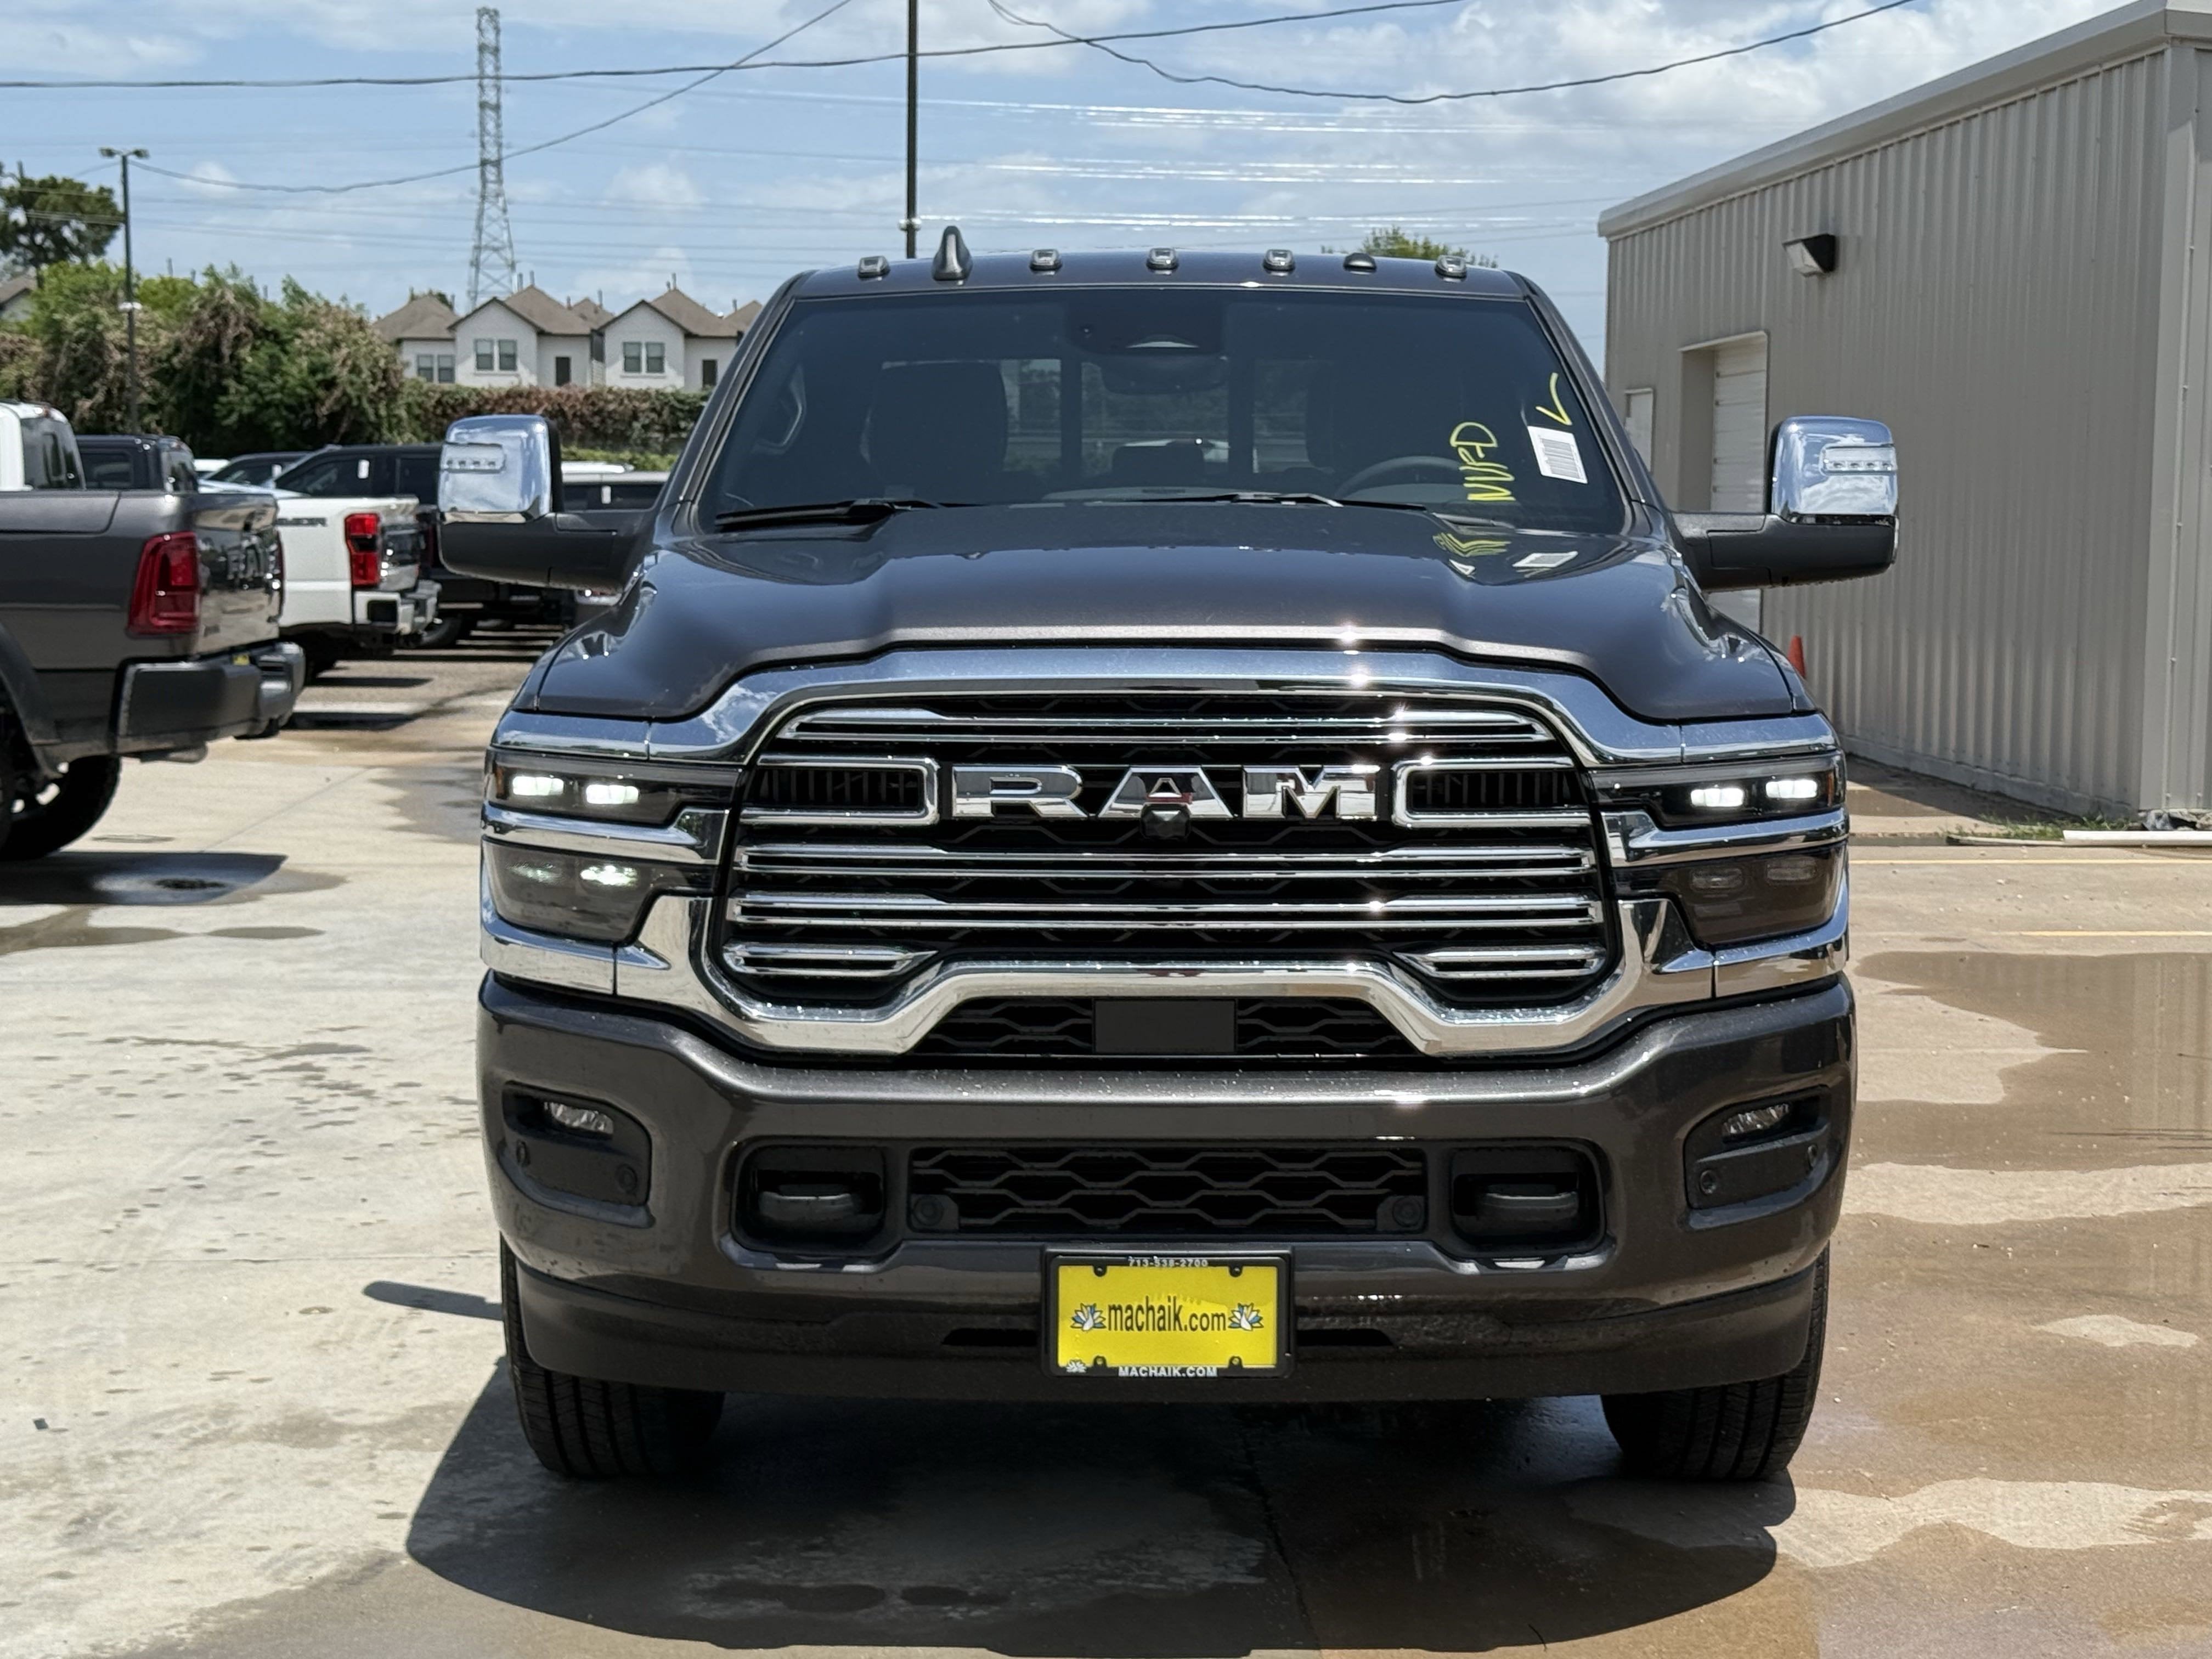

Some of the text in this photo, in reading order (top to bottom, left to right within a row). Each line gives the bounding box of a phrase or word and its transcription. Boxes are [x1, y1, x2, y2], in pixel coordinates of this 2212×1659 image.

[952, 765, 1381, 820] RAM
[1107, 1295, 1227, 1331] machaik.com
[1119, 1366, 1217, 1378] MACHAIK.COM
